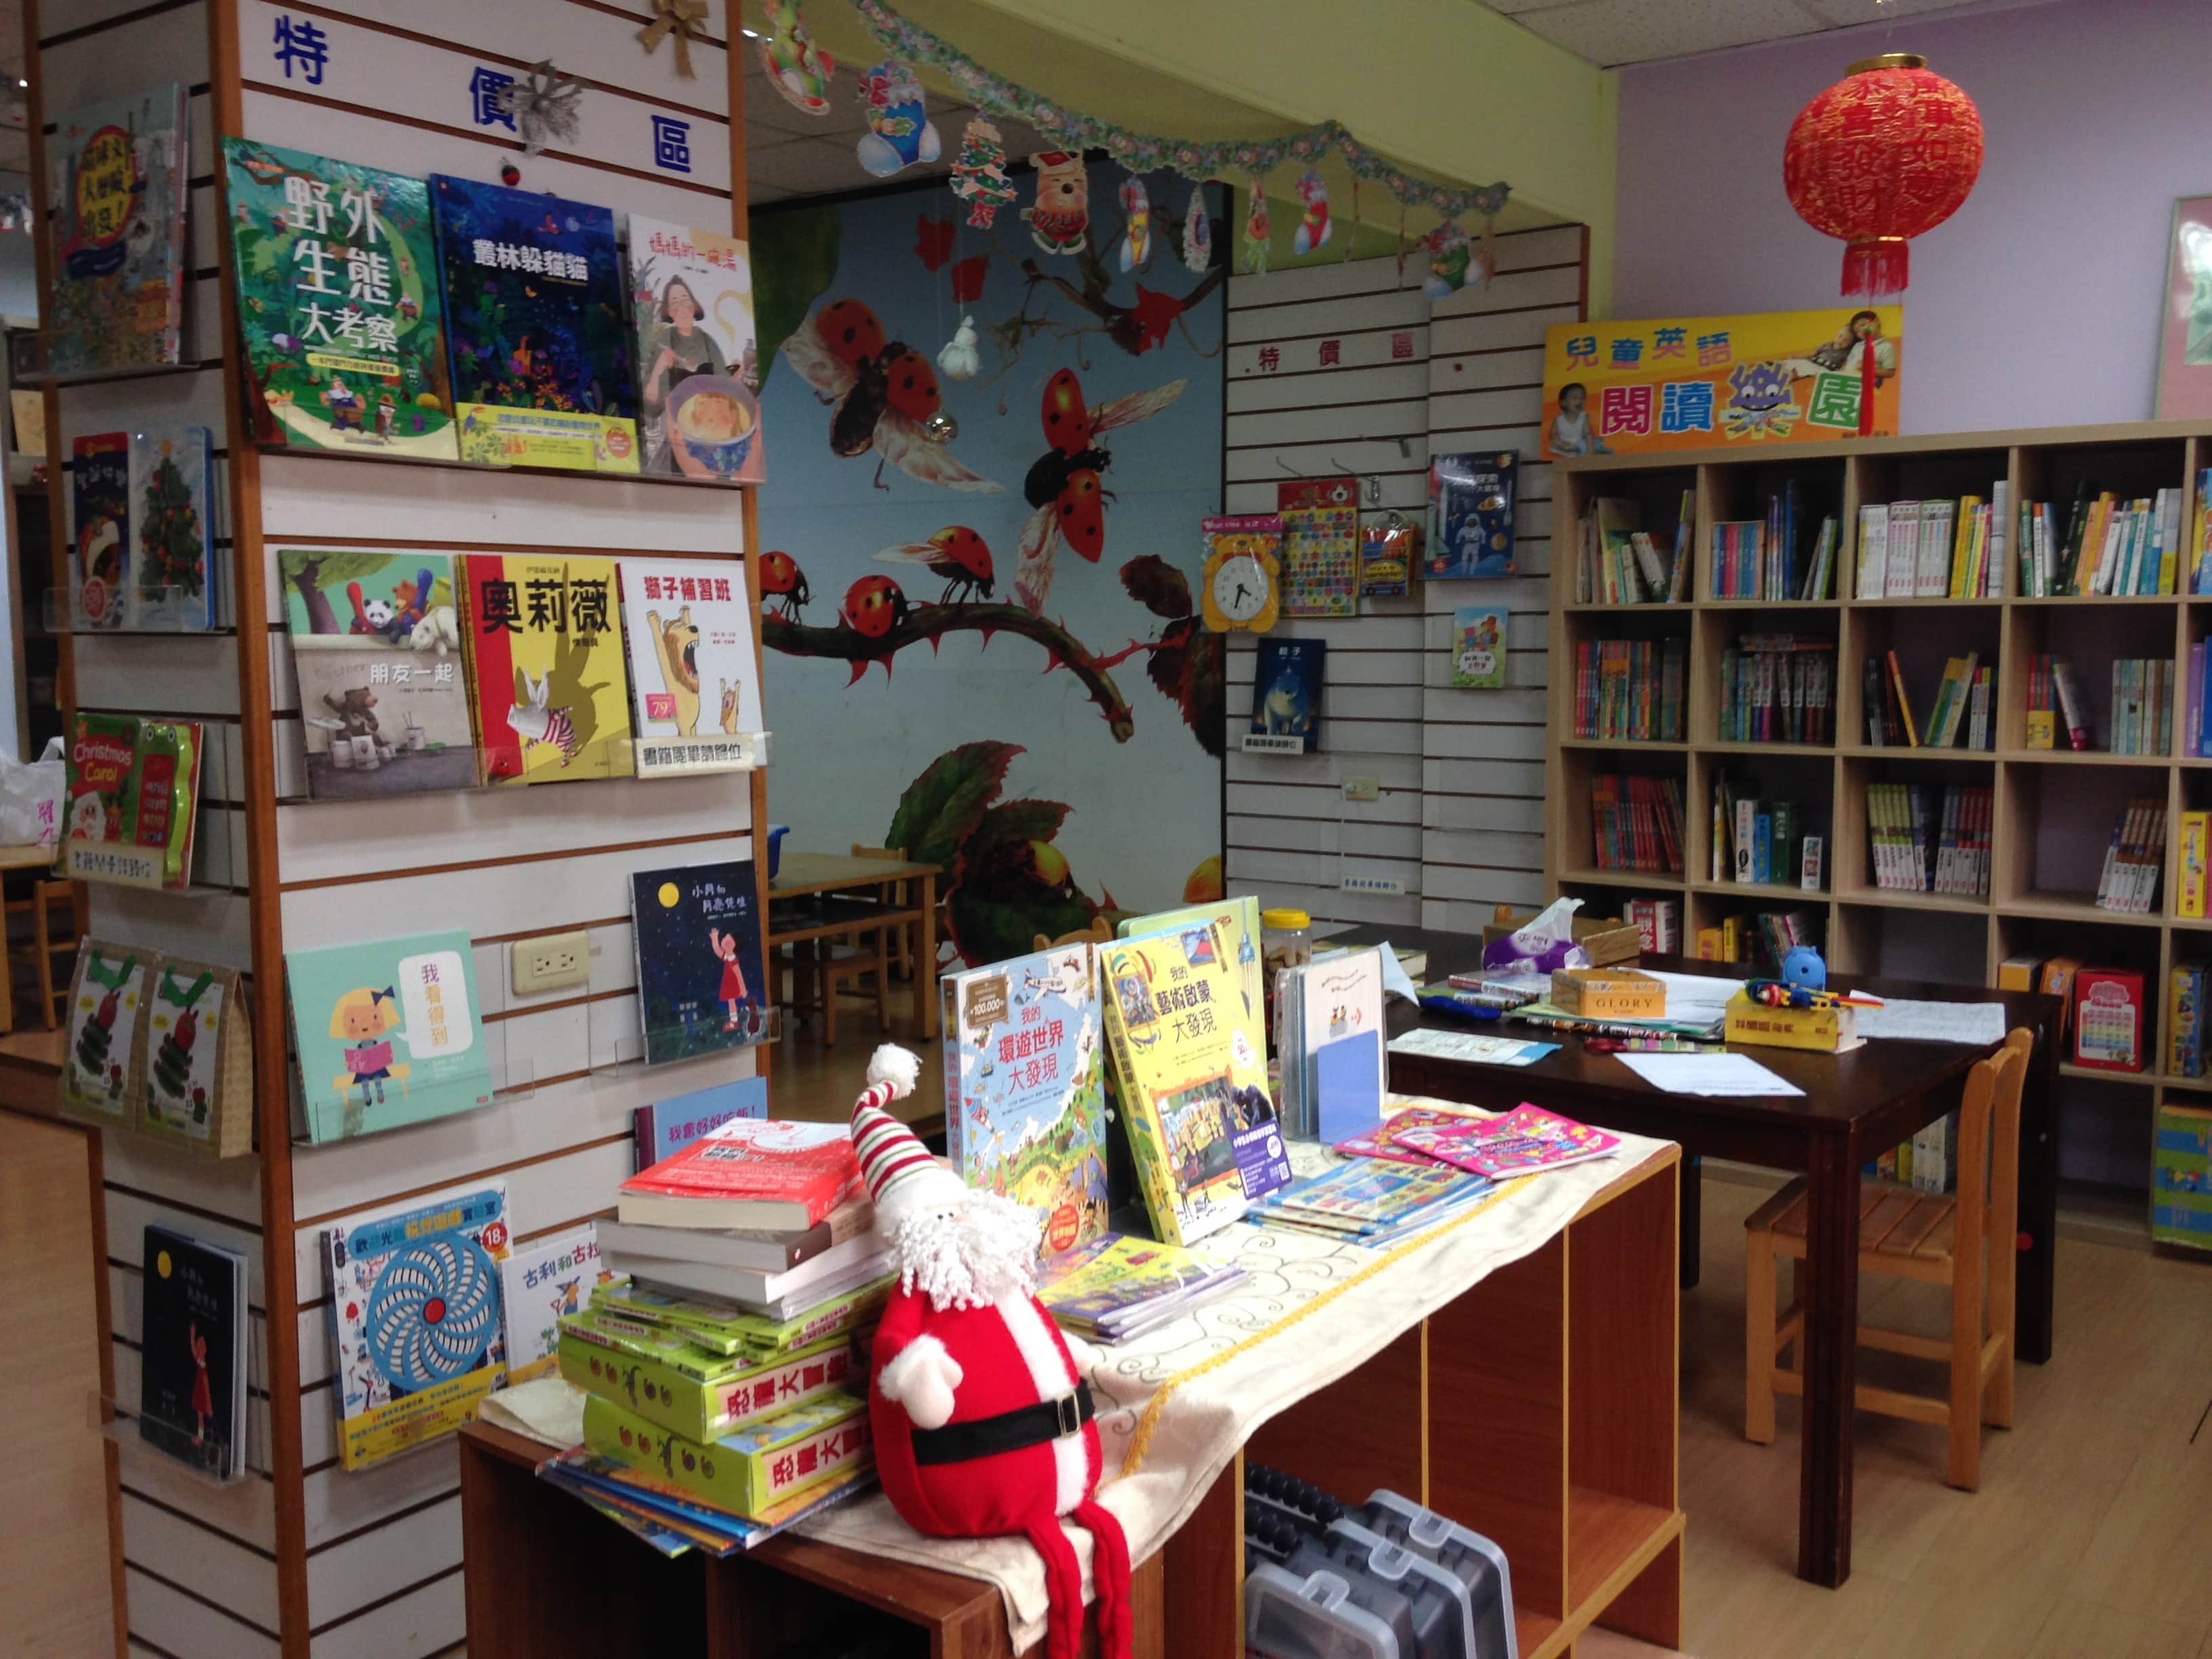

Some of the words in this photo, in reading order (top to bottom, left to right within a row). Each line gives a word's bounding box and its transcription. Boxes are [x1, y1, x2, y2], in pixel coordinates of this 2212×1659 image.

[285, 176, 386, 245] 野外
[293, 239, 392, 306] 生態
[301, 302, 398, 353] 大考察
[1258, 331, 1416, 373] 特價區
[1565, 327, 1734, 371] 兒童英語
[1599, 362, 1863, 441] 閱讀樂園
[480, 577, 612, 635] 奧莉薇
[643, 575, 732, 602] 獅子補習班
[370, 661, 454, 685] 朋友一起
[652, 701, 669, 717] 79
[73, 741, 133, 766] Christmas
[84, 762, 119, 783] Carol
[1169, 965, 1189, 983] 我的
[1021, 1005, 1042, 1026] 我的
[1595, 998, 1653, 1009] GLORY
[998, 1019, 1065, 1063] 環遊世界
[1172, 1007, 1218, 1044] 大發現
[1007, 1052, 1059, 1096] 大發現
[485, 1228, 501, 1246] 18
[523, 1242, 602, 1289] 古利和古拉
